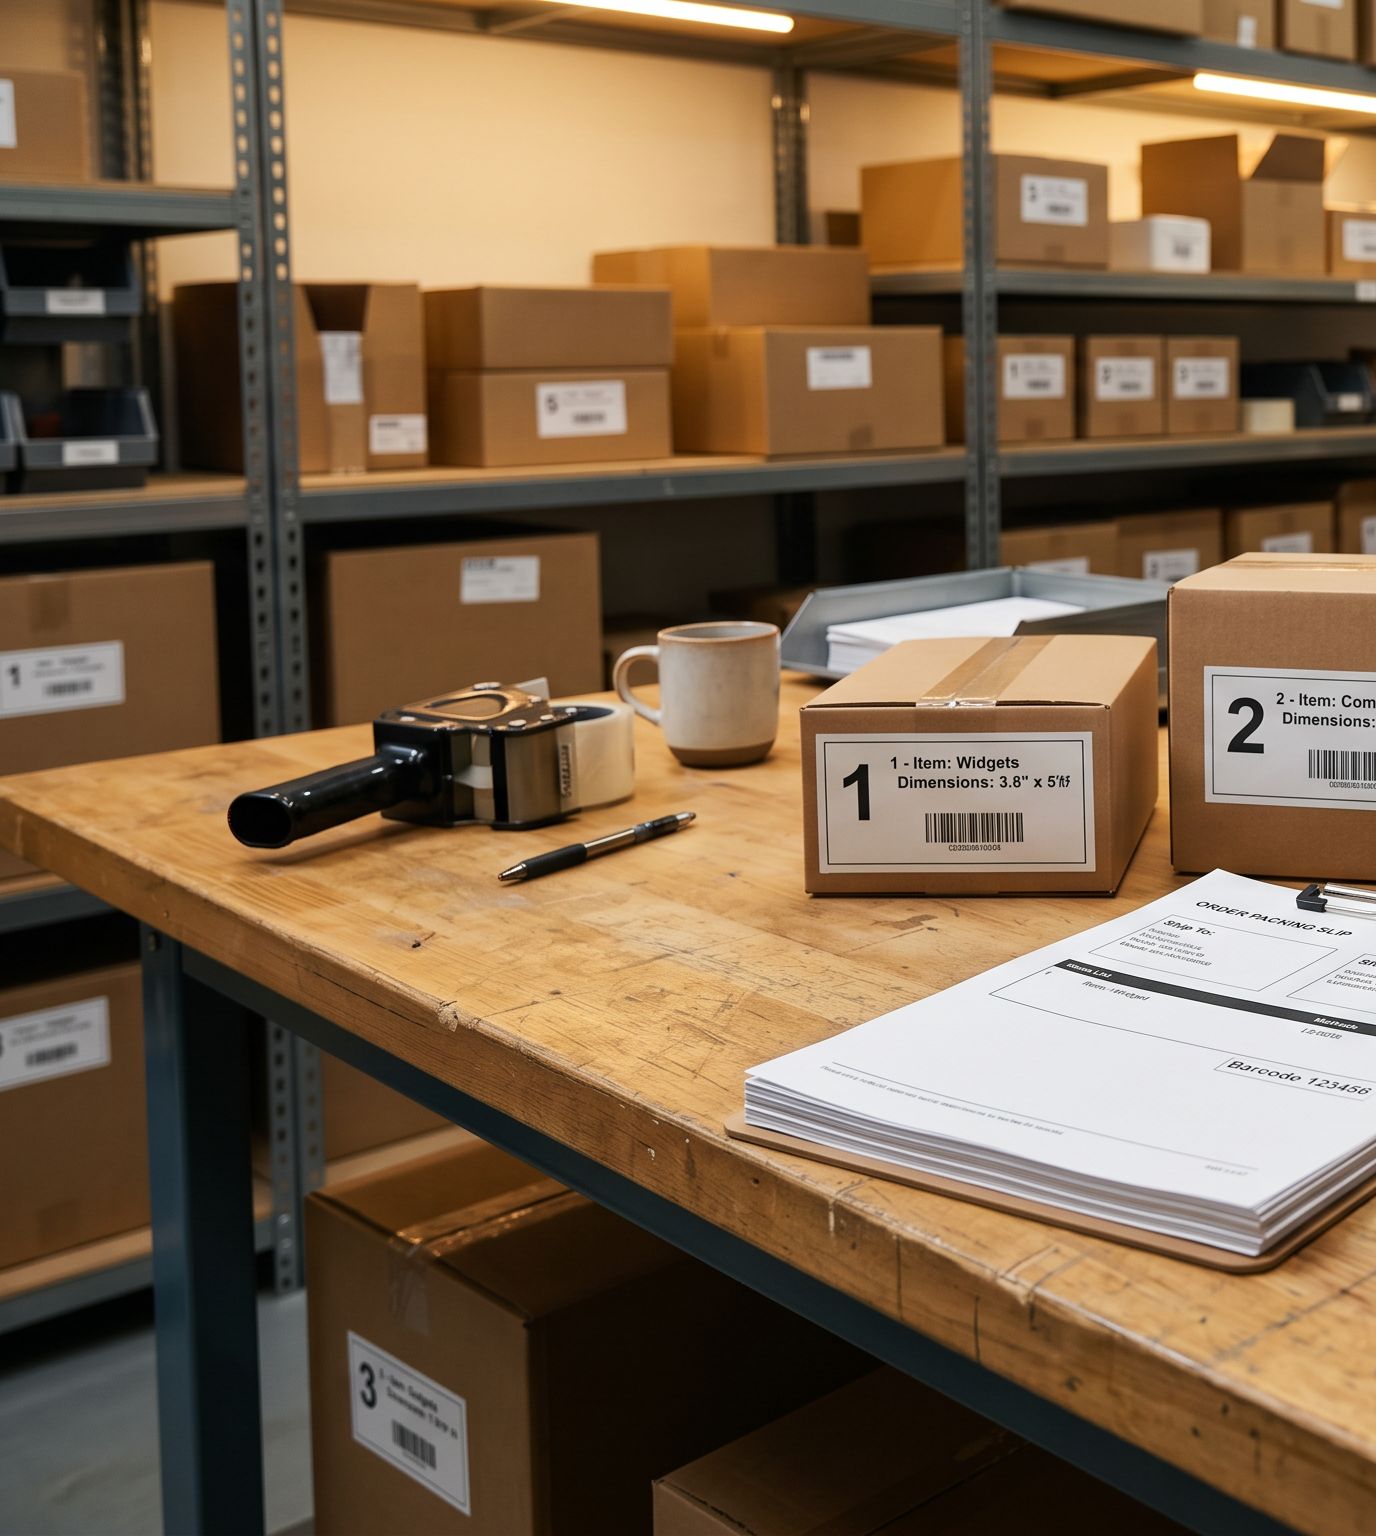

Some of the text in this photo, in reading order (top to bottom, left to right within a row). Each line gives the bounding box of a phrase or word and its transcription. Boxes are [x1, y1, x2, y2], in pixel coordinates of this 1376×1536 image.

[7, 663, 20, 688] 1
[1276, 692, 1285, 705] 2
[1298, 693, 1337, 708] Item:
[1226, 697, 1265, 754] 2
[1282, 712, 1376, 728] Dimensions:
[890, 756, 898, 769] 1
[913, 756, 952, 770] Item:
[955, 755, 1020, 773] Widgets
[842, 764, 870, 820] 1
[897, 775, 994, 789] Dimensions:
[999, 775, 1029, 789] 3.8"
[1033, 777, 1043, 788] x
[1195, 901, 1353, 937] ORDER PACKING SLIP
[1226, 1060, 1373, 1095] Barcode 123456
[360, 1361, 377, 1409] 3
